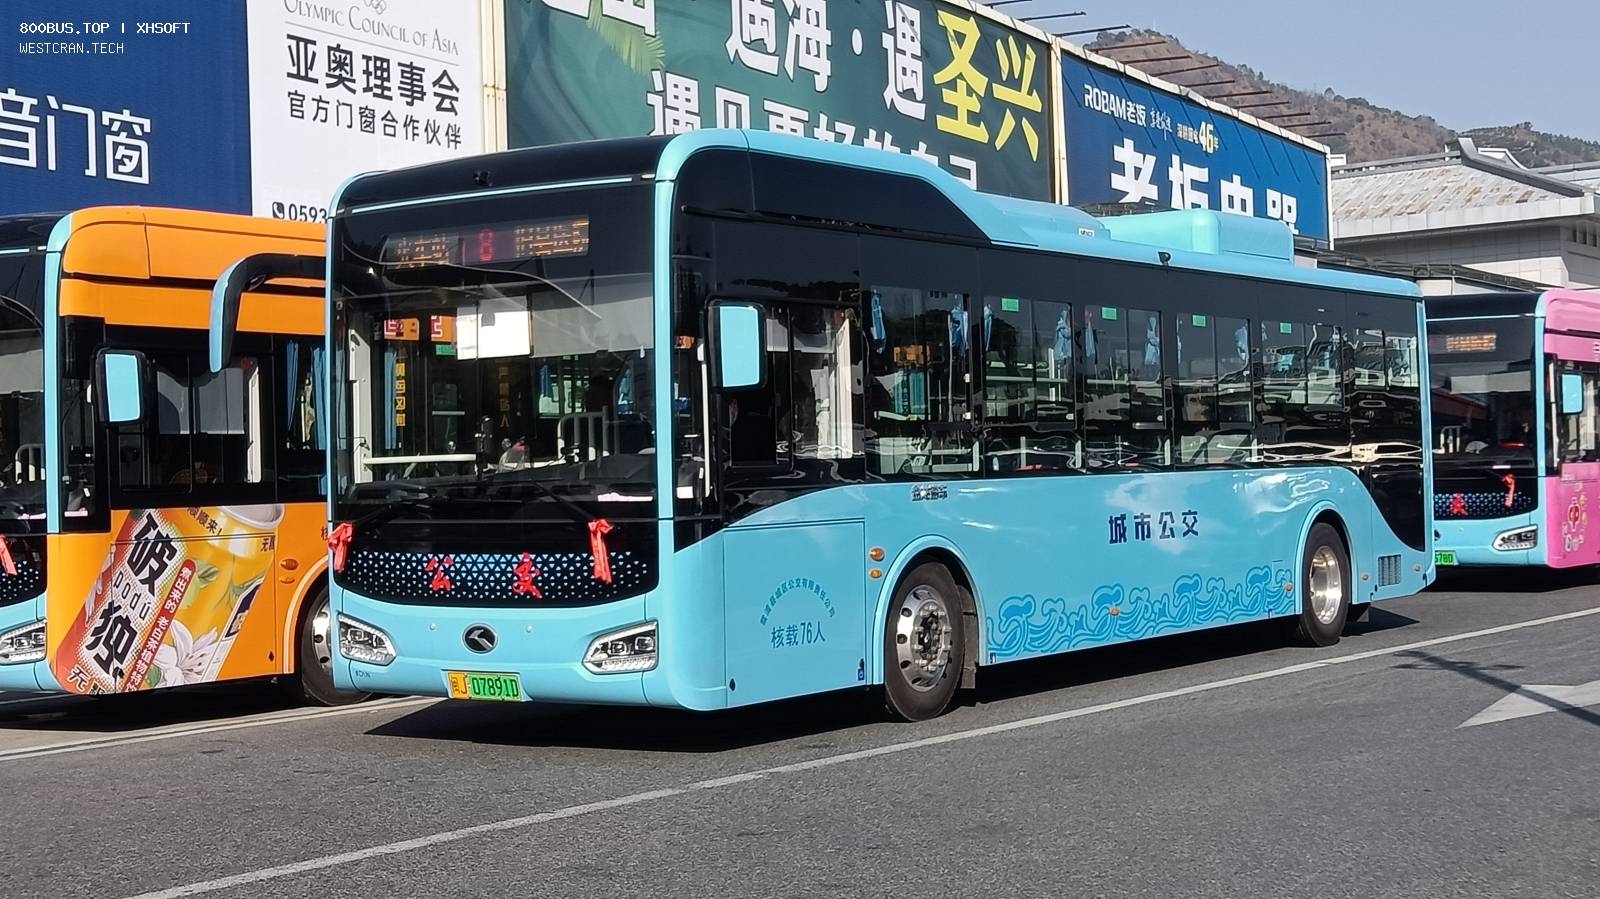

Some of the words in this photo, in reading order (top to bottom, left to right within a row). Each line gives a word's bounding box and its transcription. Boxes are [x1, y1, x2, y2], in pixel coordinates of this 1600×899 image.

[348, 6, 410, 43] COUNCIL
[431, 28, 459, 56] ASIA
[286, 33, 460, 117] 亚奥理事会
[0, 88, 152, 185] 音门窗
[287, 89, 463, 151] 官方门窗合作伙伴
[1108, 509, 1200, 545] 城市公交
[770, 620, 826, 649] 核载76人
